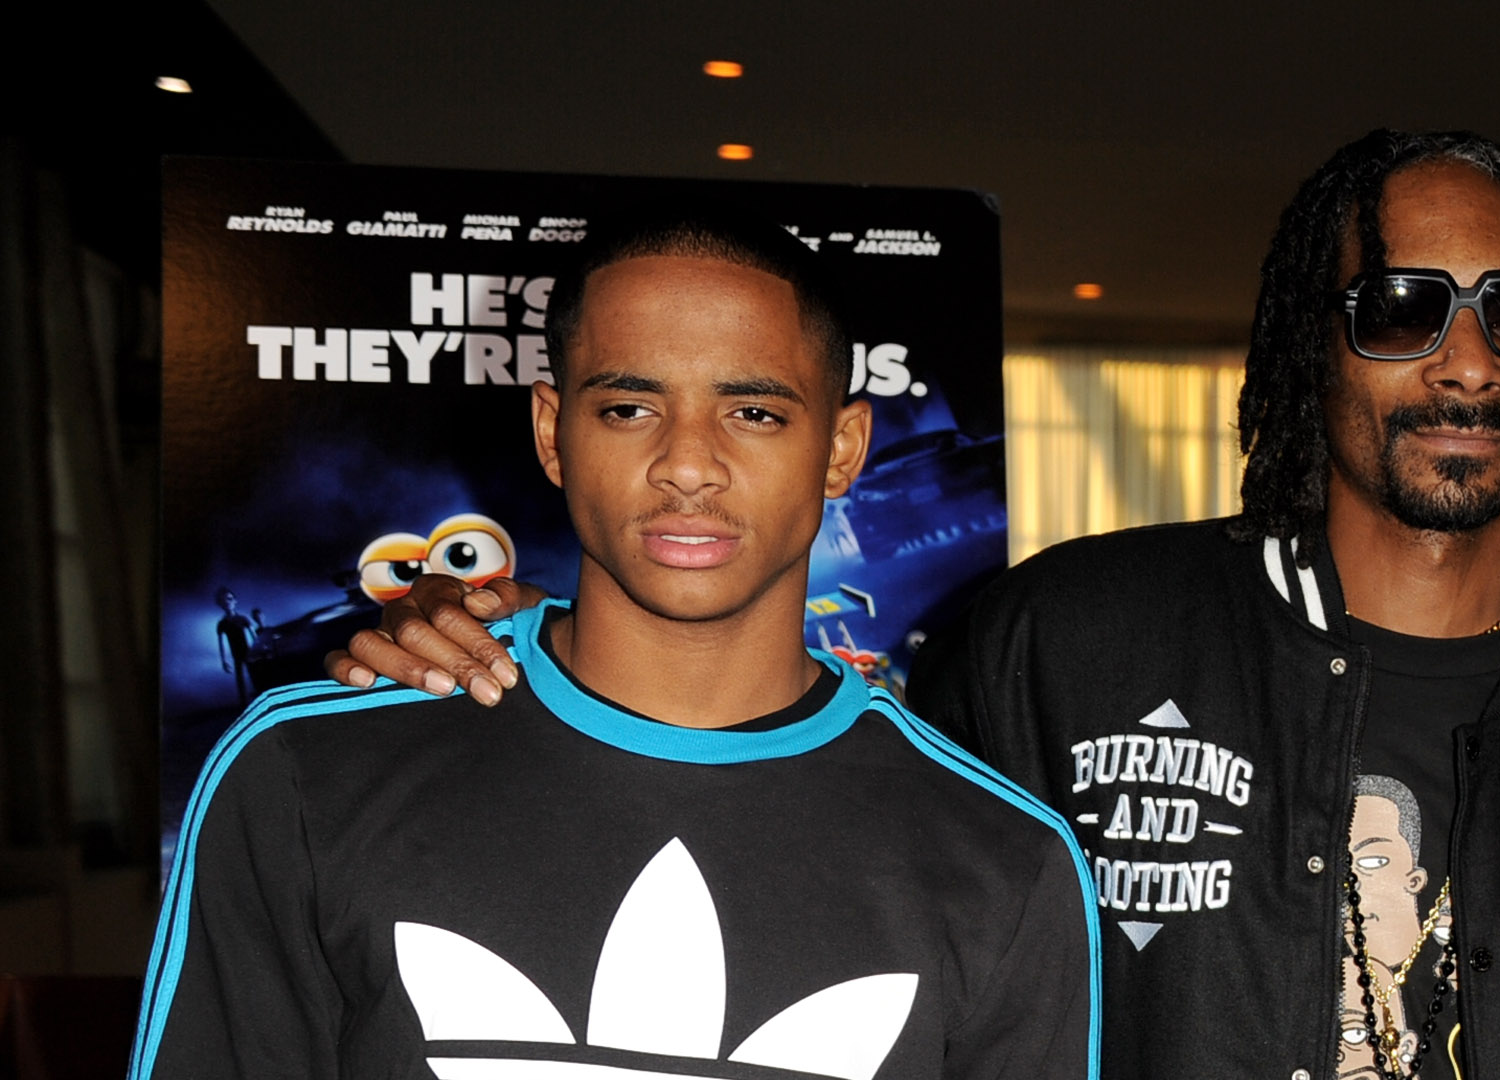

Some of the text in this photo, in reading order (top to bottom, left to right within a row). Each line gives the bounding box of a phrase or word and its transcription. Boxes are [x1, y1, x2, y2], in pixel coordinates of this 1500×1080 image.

[226, 216, 587, 242] REYNOLDS GIAMATTI PEÑA DOGG
[265, 206, 587, 229] RYAN PAUL MICHAEL SNOOP
[853, 239, 941, 256] JACKSON
[410, 272, 556, 329] HE'S
[246, 325, 557, 386] THEY'RE
[1071, 734, 1254, 807] BURNING
[1103, 793, 1199, 842] AND
[1092, 856, 1233, 912] OOTING
